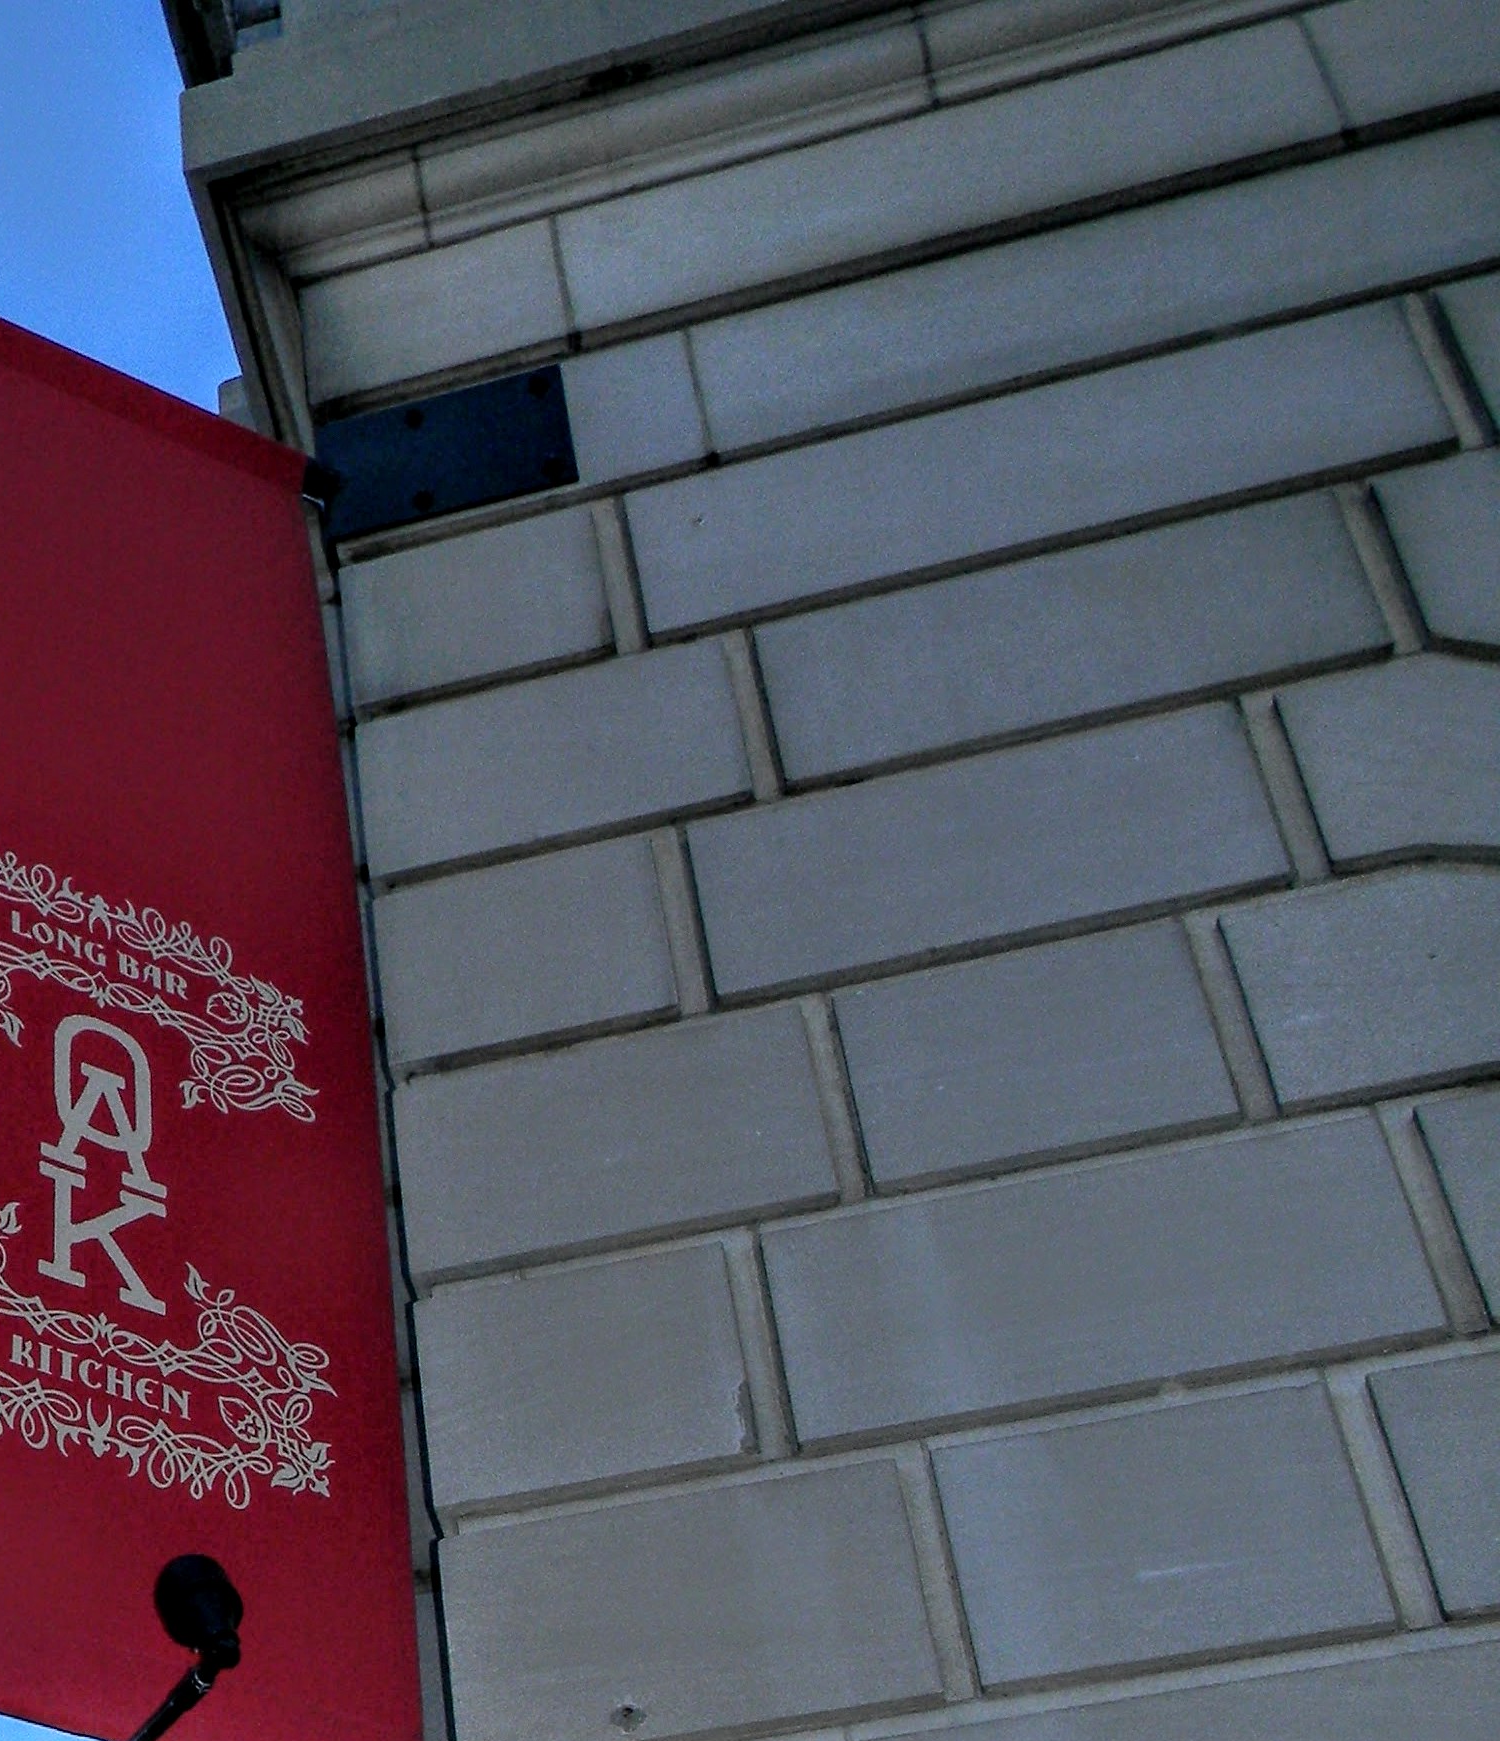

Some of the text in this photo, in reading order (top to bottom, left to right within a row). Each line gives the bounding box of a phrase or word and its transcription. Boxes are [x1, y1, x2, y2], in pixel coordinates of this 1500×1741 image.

[12, 911, 188, 1001] LONG BAR
[38, 1013, 168, 1316] OAK
[10, 1334, 192, 1421] KITCHEN
